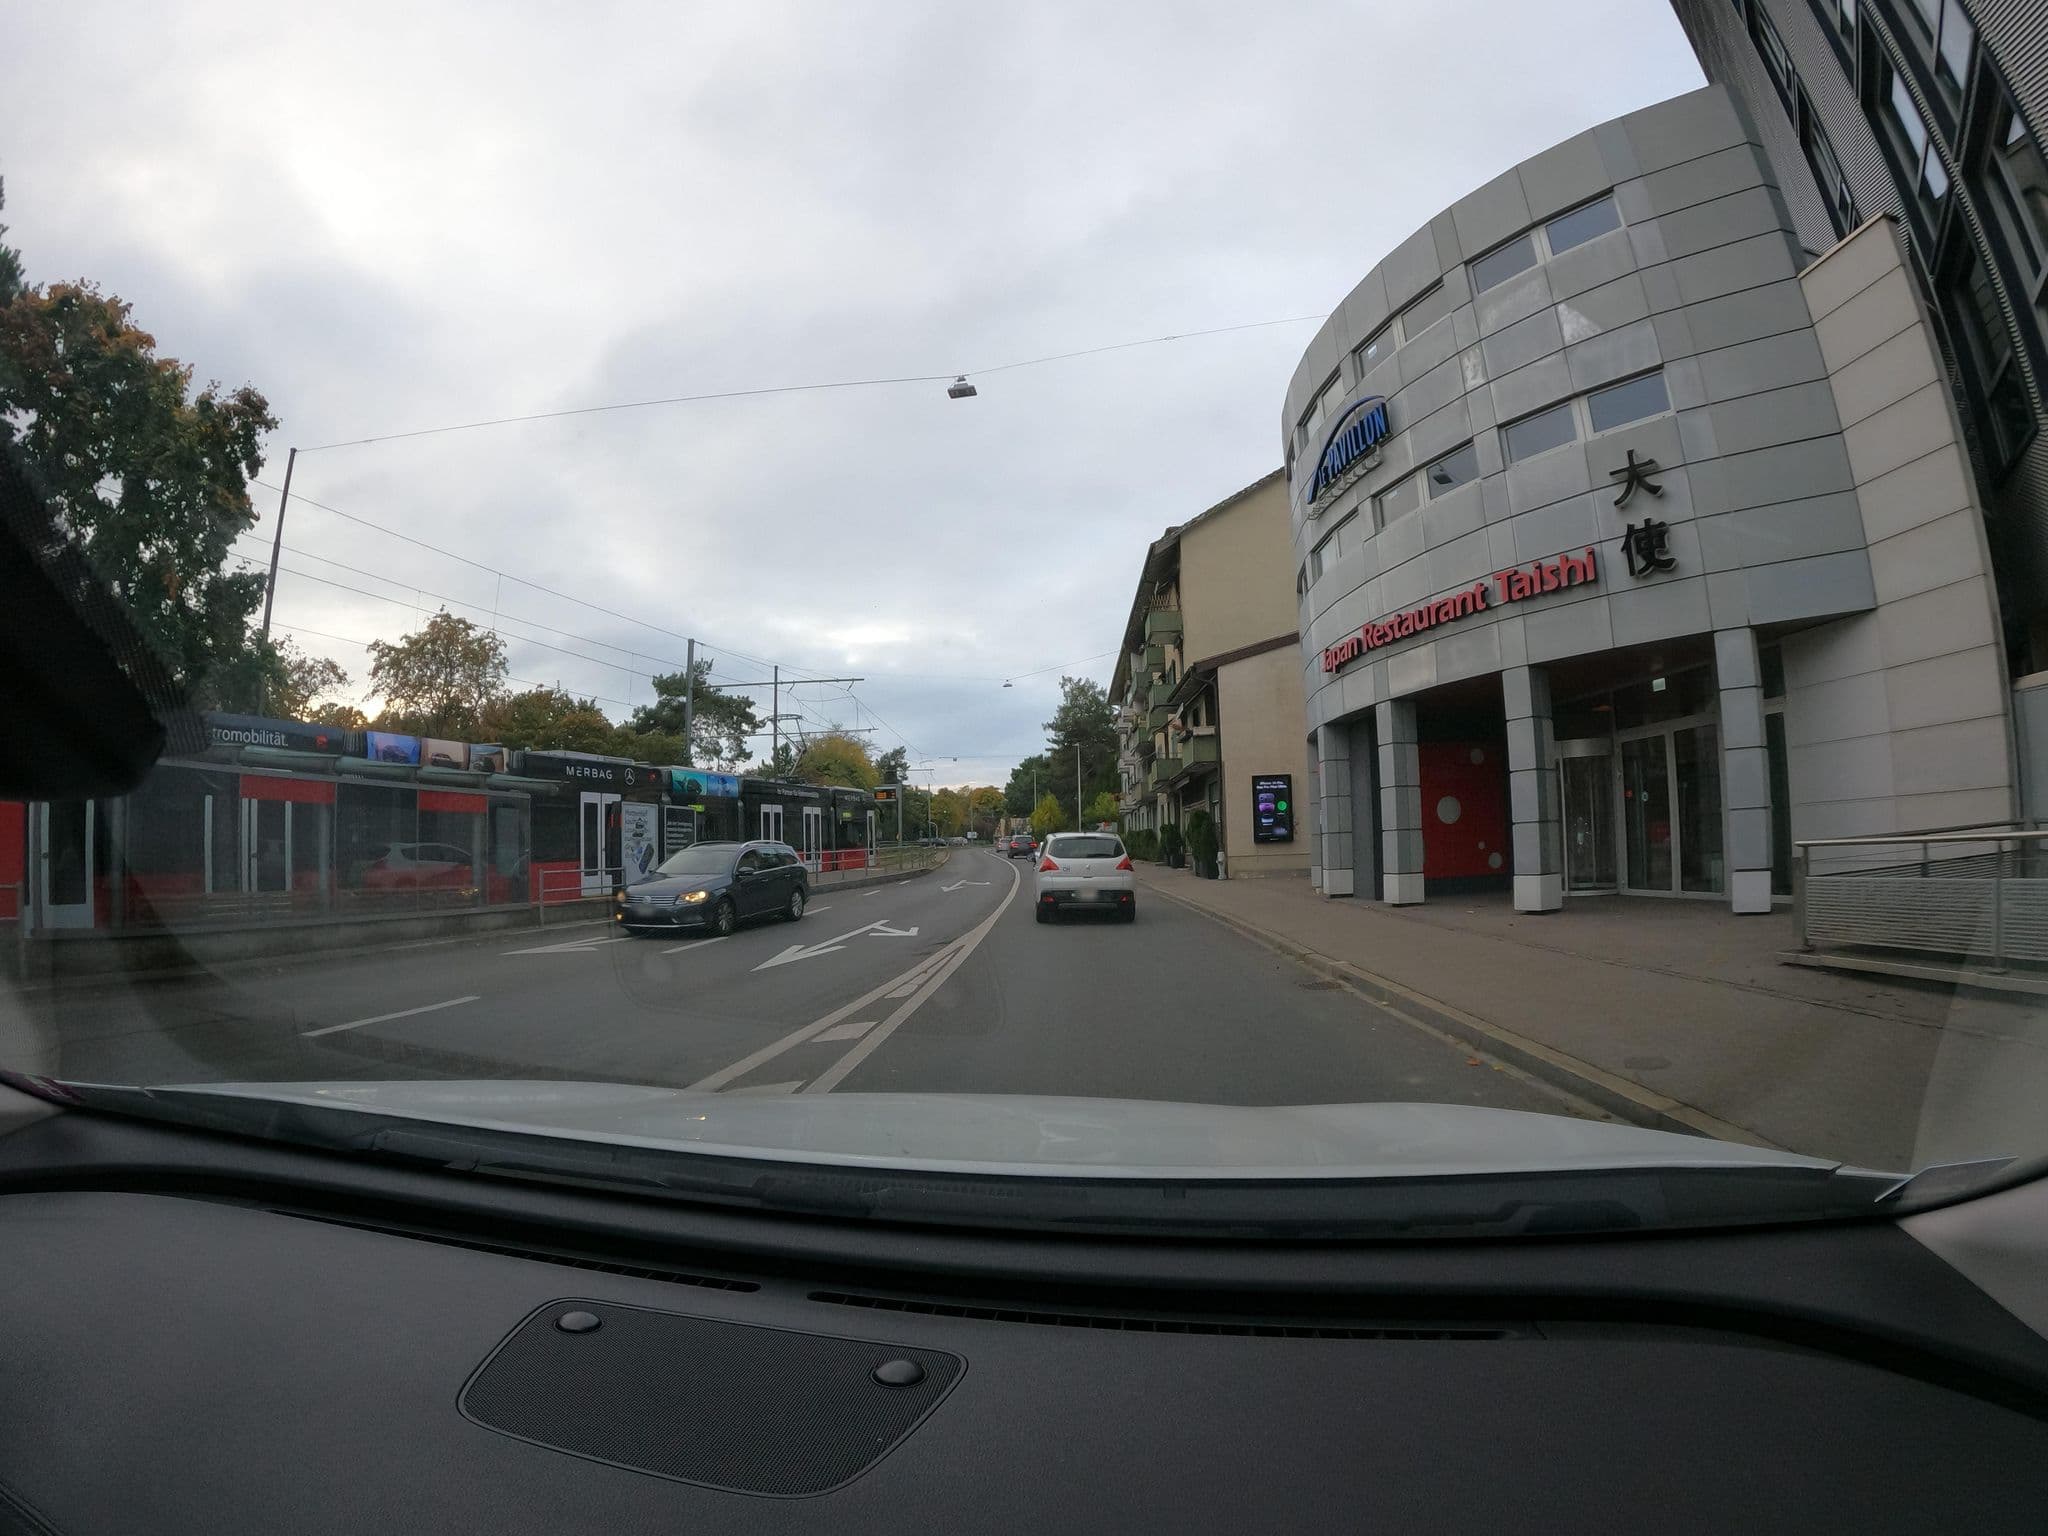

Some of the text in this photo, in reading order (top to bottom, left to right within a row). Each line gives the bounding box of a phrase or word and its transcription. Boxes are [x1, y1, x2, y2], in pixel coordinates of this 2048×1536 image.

[1327, 405, 1386, 480] PAVILLON
[1322, 547, 1597, 673] Japan Restaurant Taishi
[566, 765, 613, 780] MERBAG
